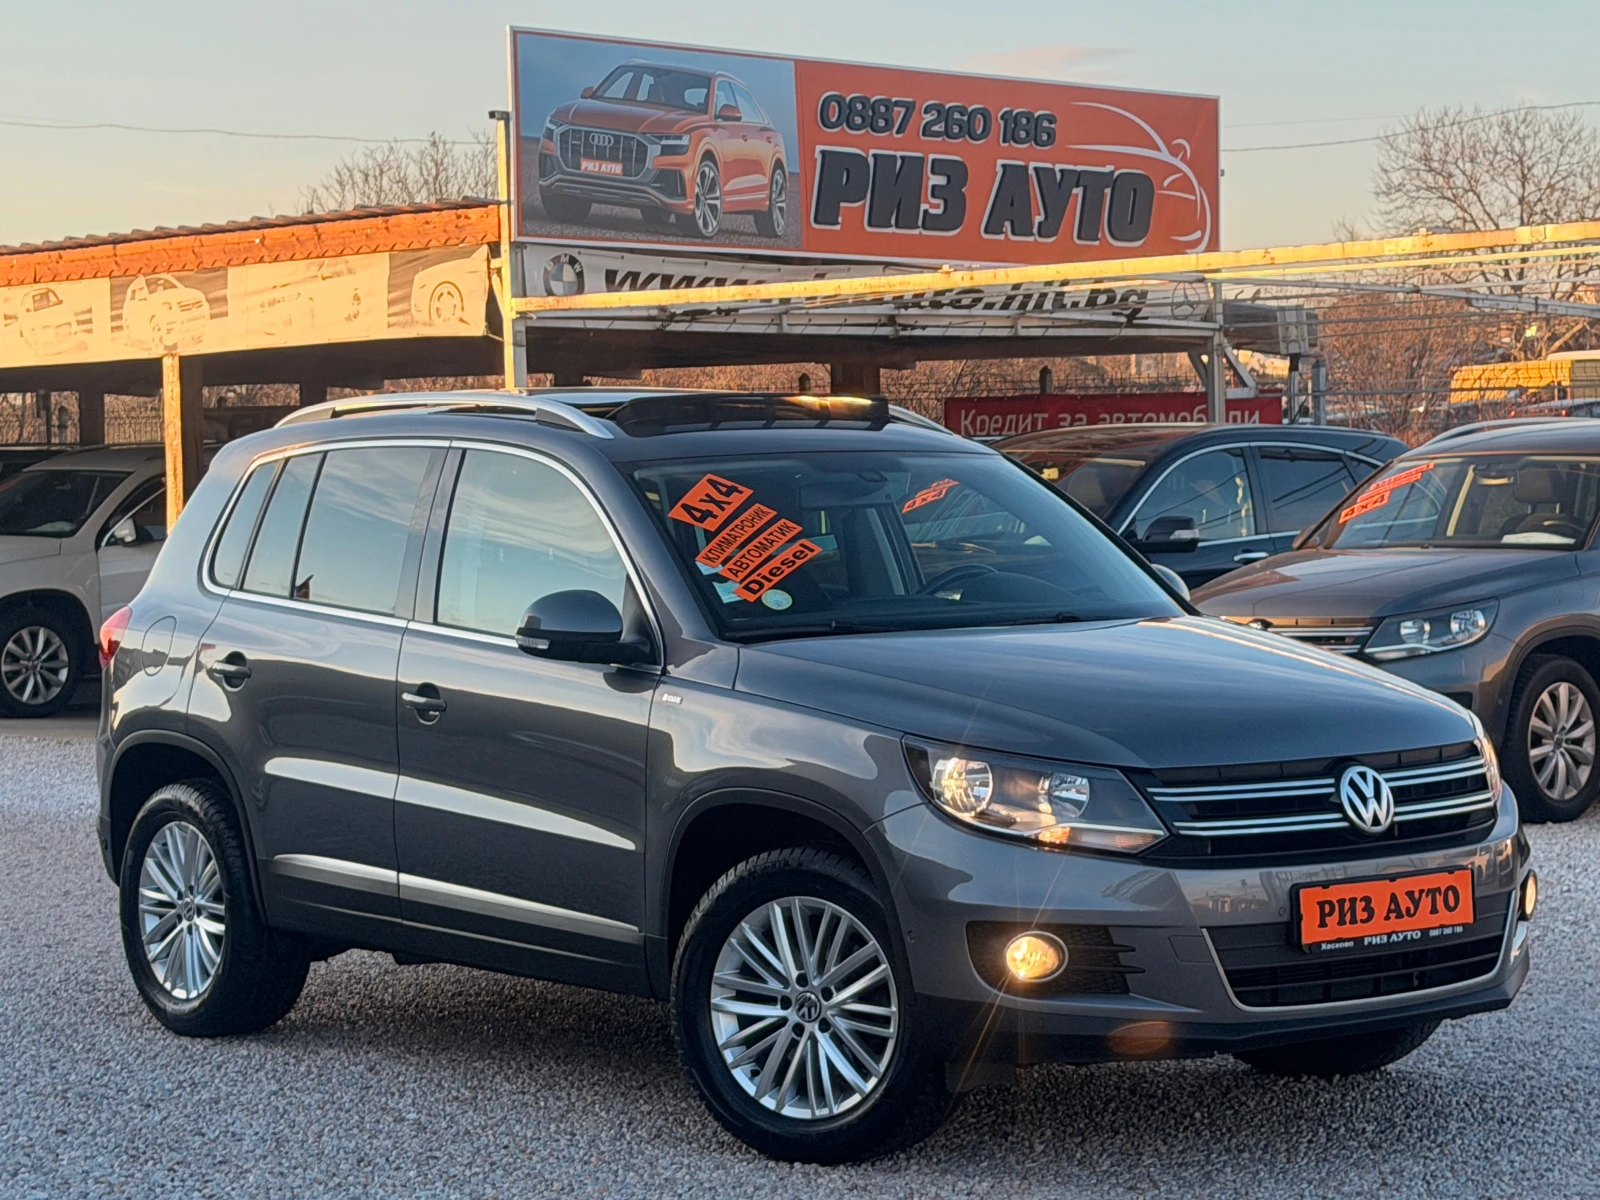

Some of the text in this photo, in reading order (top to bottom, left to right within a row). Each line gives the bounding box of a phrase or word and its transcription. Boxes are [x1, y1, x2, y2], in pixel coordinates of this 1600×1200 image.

[818, 92, 1058, 149] 0887 260 186
[811, 145, 1155, 247] РИЗ АУТО
[960, 409, 1049, 436] Кредит
[702, 507, 771, 564] КЛИМАТРОНИК
[726, 522, 797, 578] АВТОМАТИК
[741, 542, 815, 595] Diesel
[1316, 884, 1461, 928] РИЗ АУТО
[1363, 933, 1388, 946] РИЗ
[1390, 930, 1422, 943] АУТО
